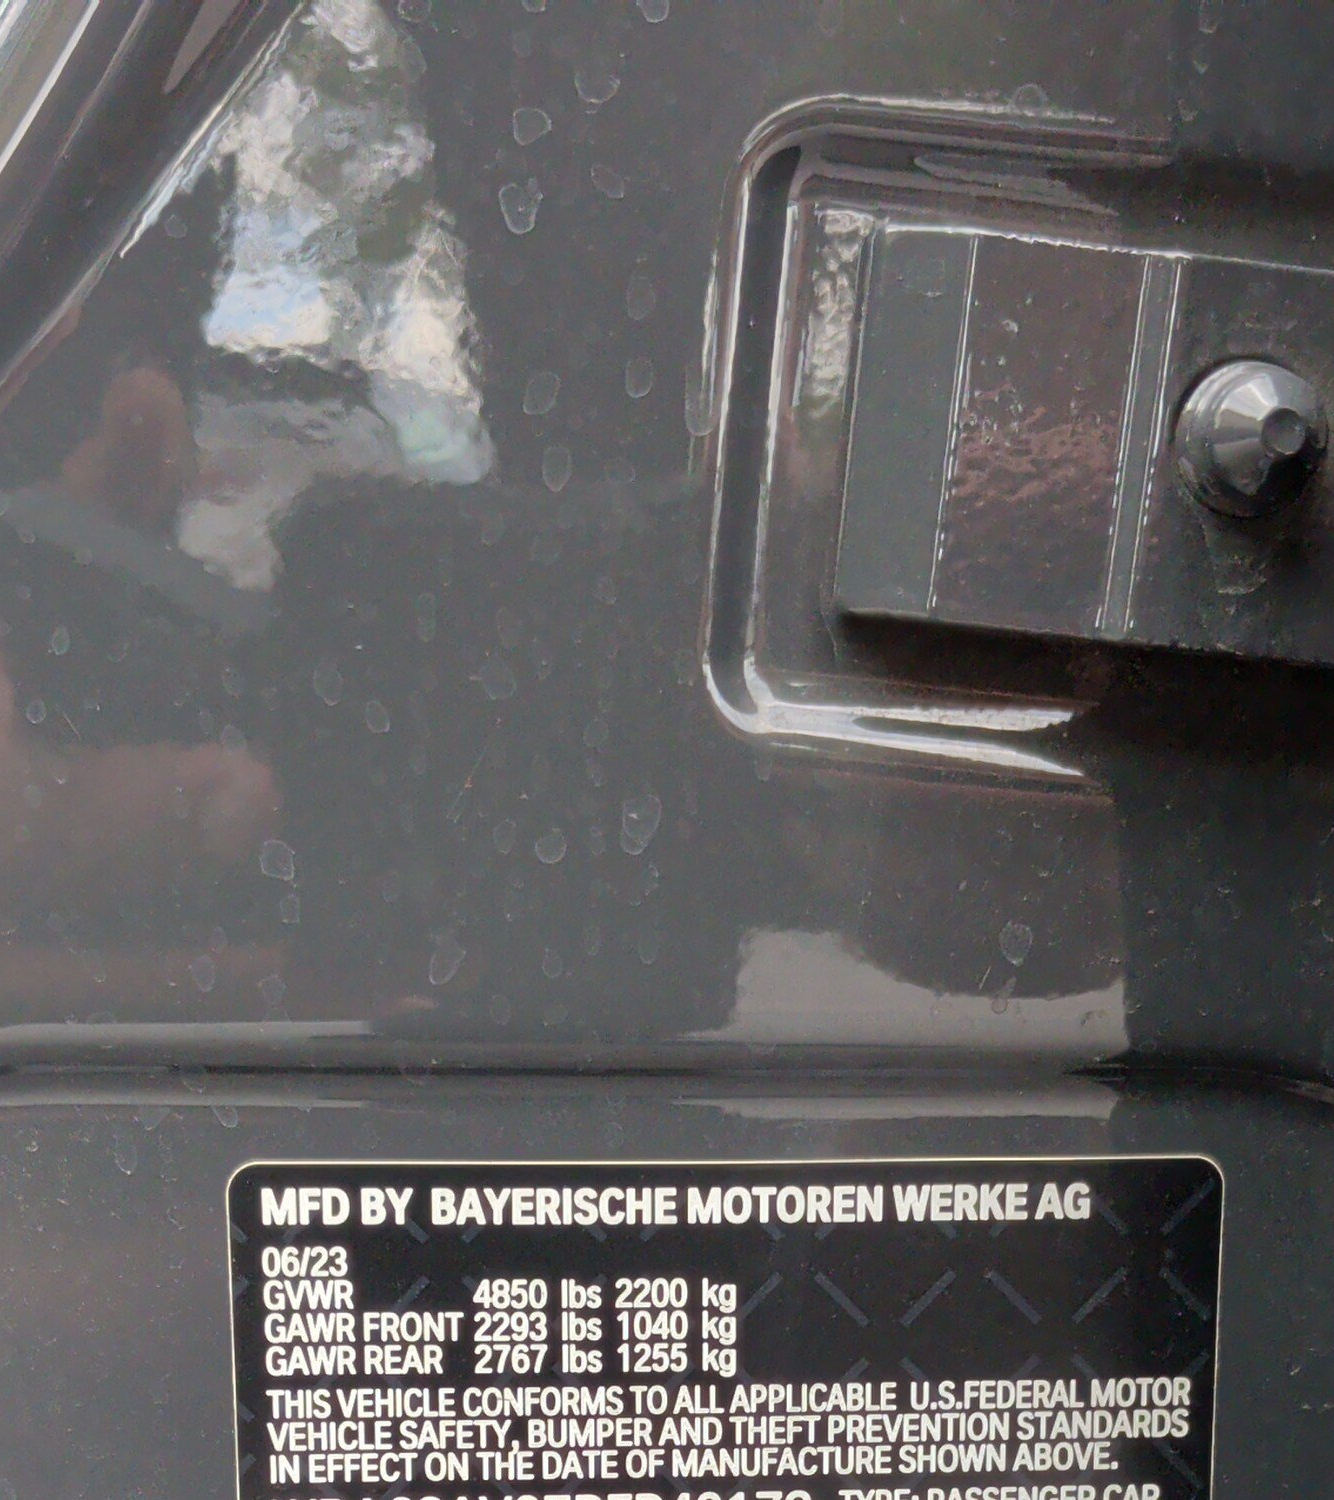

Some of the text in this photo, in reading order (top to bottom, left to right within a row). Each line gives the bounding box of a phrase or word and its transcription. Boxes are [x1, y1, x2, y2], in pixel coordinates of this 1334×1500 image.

[261, 1182, 1090, 1225] MFD BY BAYERISCHE MOTOREN WERKE AG
[261, 1246, 348, 1278] 06/23
[263, 1278, 736, 1313] GVWR 4850 lbs 2200 kg
[264, 1310, 736, 1345] GAWR FRONT 2293 lbs 1040 kg
[265, 1342, 736, 1378] GAWR REAR 2767 lbs 1255 kg
[265, 1388, 331, 1419] THIS
[336, 1388, 456, 1418] VEHICLE
[463, 1386, 624, 1417] CONFORMS
[629, 1385, 668, 1415] TO
[673, 1385, 725, 1414] ALL
[729, 1382, 897, 1413] APPLICABLE
[1091, 1377, 1190, 1407] MOTOR
[266, 1408, 1189, 1457] VEHICLE SAFETY, BUMPER AND THEFT PREVENTION STANDARDS
[270, 1441, 1118, 1484] IN EFFECT ON THE DATE OF MANUFACTURE SHOWN ABOVE.
